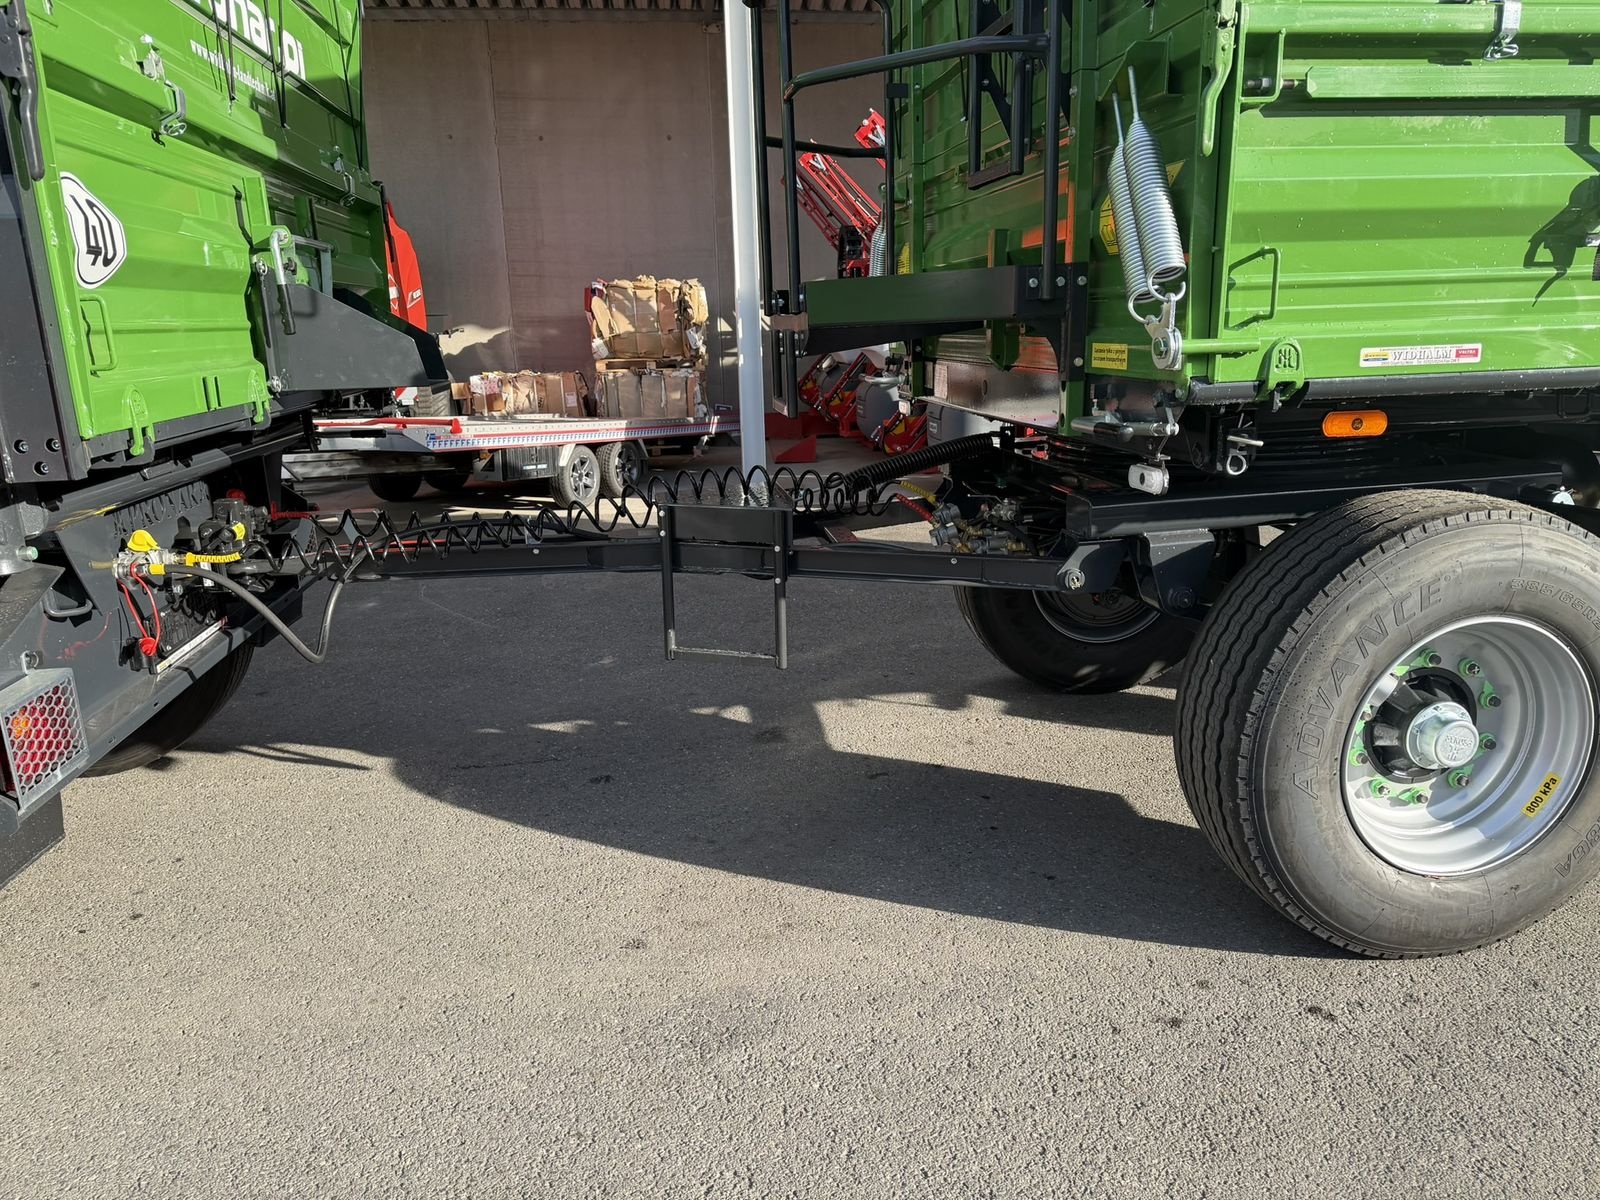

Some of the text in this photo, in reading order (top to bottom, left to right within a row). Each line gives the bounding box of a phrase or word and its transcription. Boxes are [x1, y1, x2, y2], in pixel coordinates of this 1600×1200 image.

[69, 193, 118, 268] 40
[1392, 349, 1453, 361] WIDHALM
[1292, 577, 1443, 801] ADVANCE
[1525, 777, 1558, 814] 800 kPa
[1554, 817, 1600, 879] 86A
